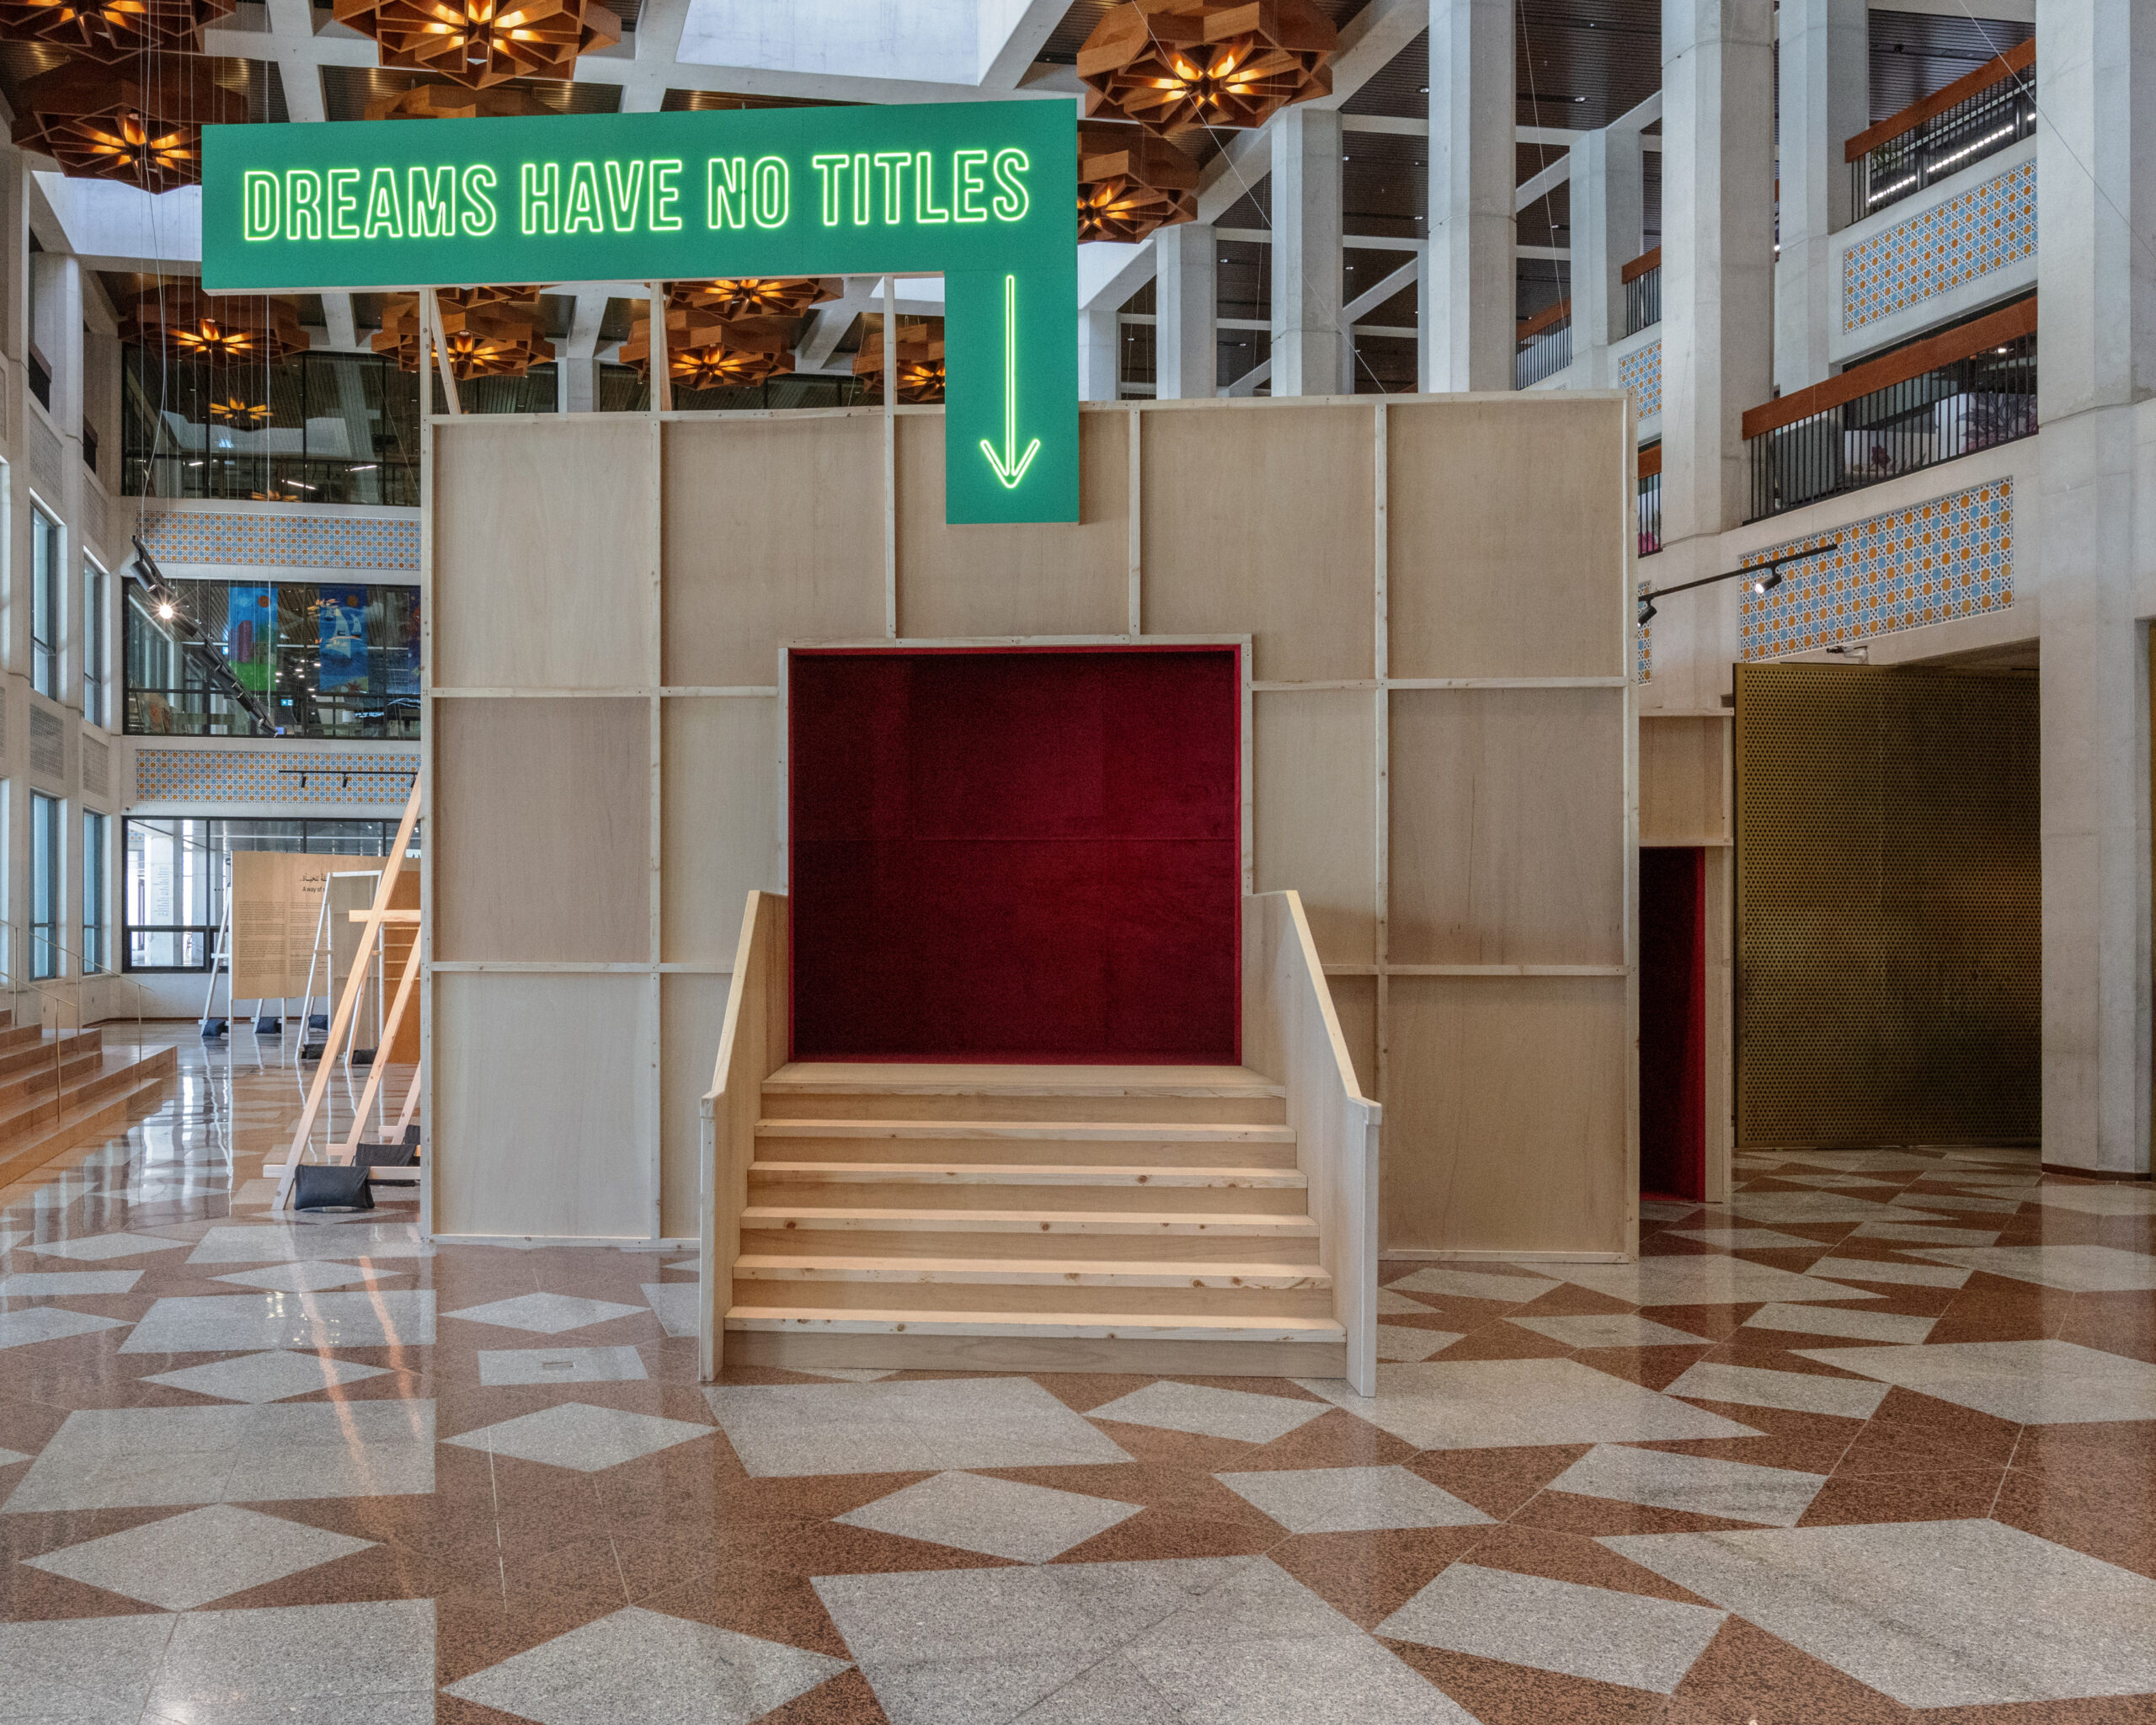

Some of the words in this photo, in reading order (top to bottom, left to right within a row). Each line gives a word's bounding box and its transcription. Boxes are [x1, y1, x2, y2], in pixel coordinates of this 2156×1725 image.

[243, 164, 498, 241] DREAMS
[520, 158, 683, 236] HAVE
[707, 156, 790, 230] NO
[811, 147, 1030, 227] TITLES
